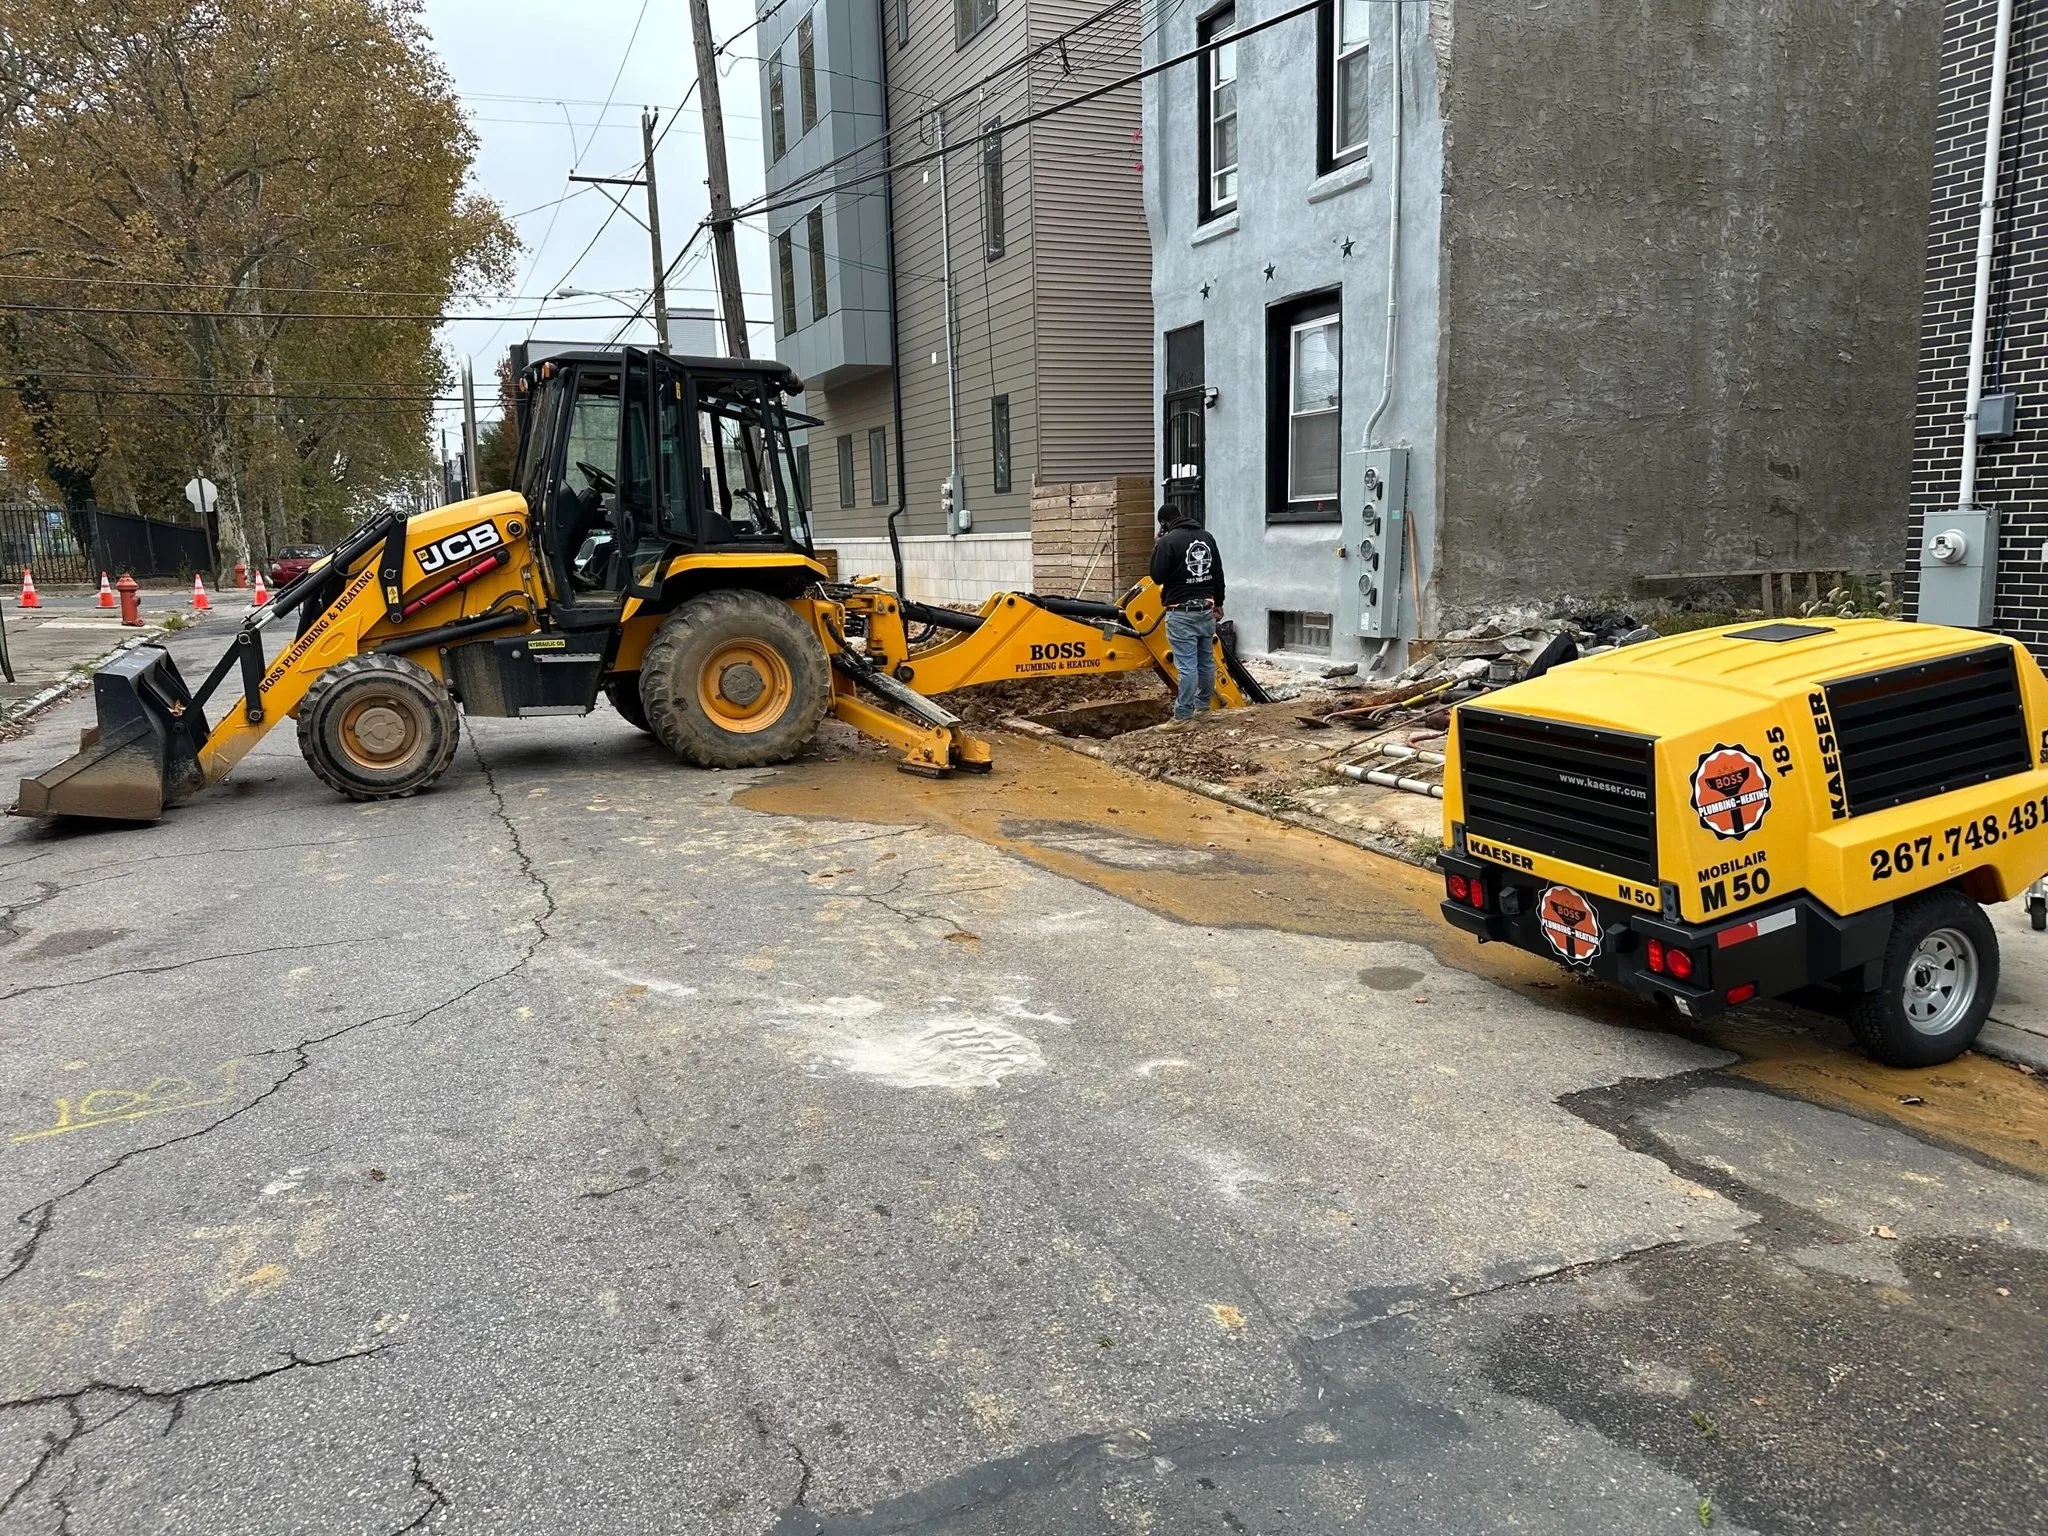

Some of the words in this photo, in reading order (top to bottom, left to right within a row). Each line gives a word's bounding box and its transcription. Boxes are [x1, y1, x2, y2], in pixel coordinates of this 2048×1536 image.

[421, 523, 499, 571] JCB
[260, 666, 286, 694] BOSS
[282, 620, 329, 669] PLUMBING
[327, 611, 338, 621] &
[335, 570, 375, 612] HEATING
[1015, 661, 1056, 672] PLUMBING
[1058, 661, 1065, 669] &
[1066, 659, 1100, 669] HEATING
[1030, 641, 1086, 661] BOSS
[1766, 726, 1793, 777] 185
[1808, 691, 1847, 820] KAESER
[1559, 773, 1647, 799] www.kaeser.com
[1715, 772, 1744, 789] BOSS
[1470, 839, 1534, 871] KAESER
[1698, 850, 1767, 882] MOBILAIR
[1618, 884, 1632, 901] M
[1635, 890, 1655, 907] 50
[1700, 880, 1727, 913] M
[1733, 867, 1771, 902] 50
[1556, 905, 1581, 921] BOSS
